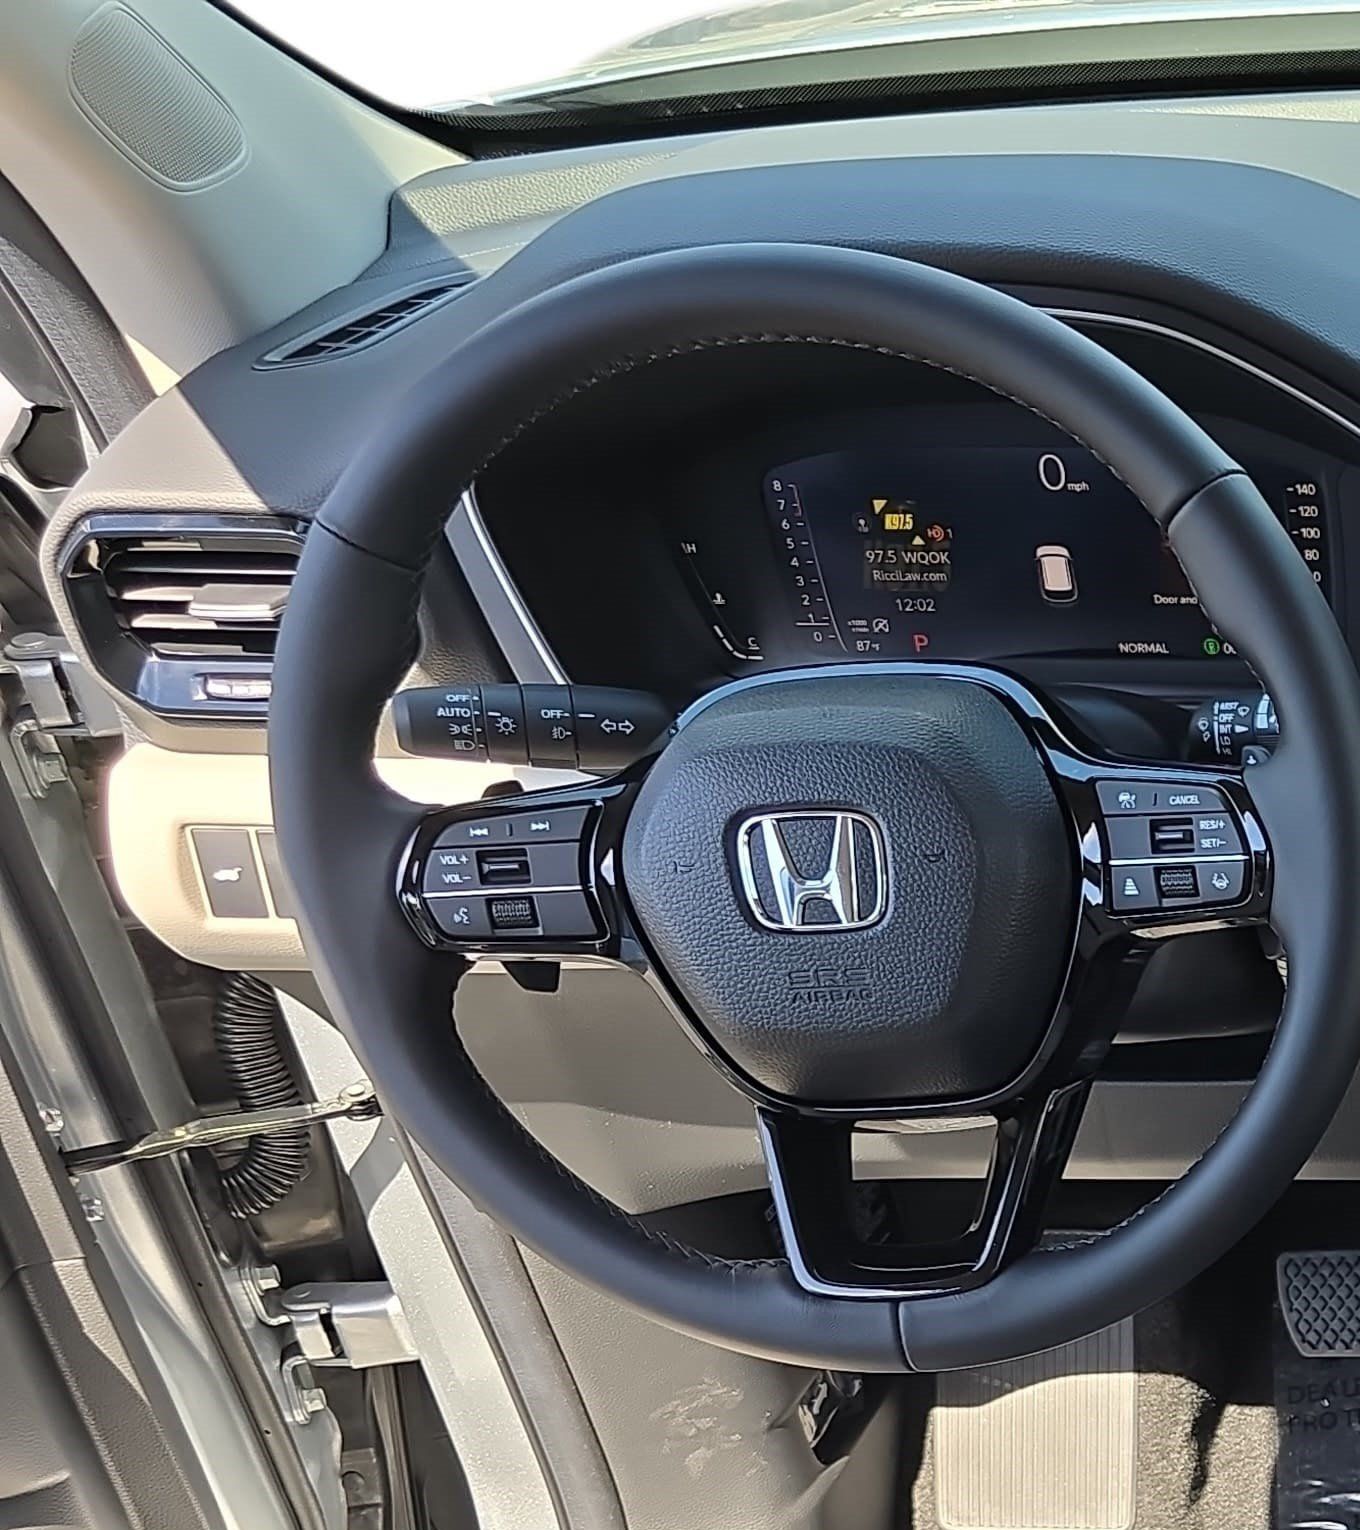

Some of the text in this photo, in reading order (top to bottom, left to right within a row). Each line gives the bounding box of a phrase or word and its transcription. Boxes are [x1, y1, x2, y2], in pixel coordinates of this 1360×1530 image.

[1038, 453, 1090, 493] 0 mph
[773, 481, 782, 491] 8
[1295, 484, 1317, 496] 140
[777, 500, 785, 511] 7
[1298, 505, 1319, 517] 120
[781, 519, 790, 530] 6
[884, 513, 914, 531] K97.5
[1300, 527, 1321, 539] 100
[786, 538, 794, 549] 5
[866, 550, 951, 565] 97.5 WQOK
[1304, 549, 1320, 560] 80
[790, 556, 799, 567] 4
[796, 576, 804, 586] 3
[872, 569, 948, 582] RicciLaw.com
[802, 594, 810, 605] 2
[1153, 594, 1178, 604] Door
[896, 598, 936, 612] 12:02
[813, 631, 823, 642] 0
[913, 634, 929, 652] P
[1118, 642, 1170, 654] NORMAL
[446, 694, 470, 702] OFF
[437, 707, 471, 718] AUTO
[540, 709, 564, 719] OFF
[1219, 713, 1235, 722] OFF
[1169, 795, 1200, 805] CANCEL
[787, 968, 873, 987] SRS
